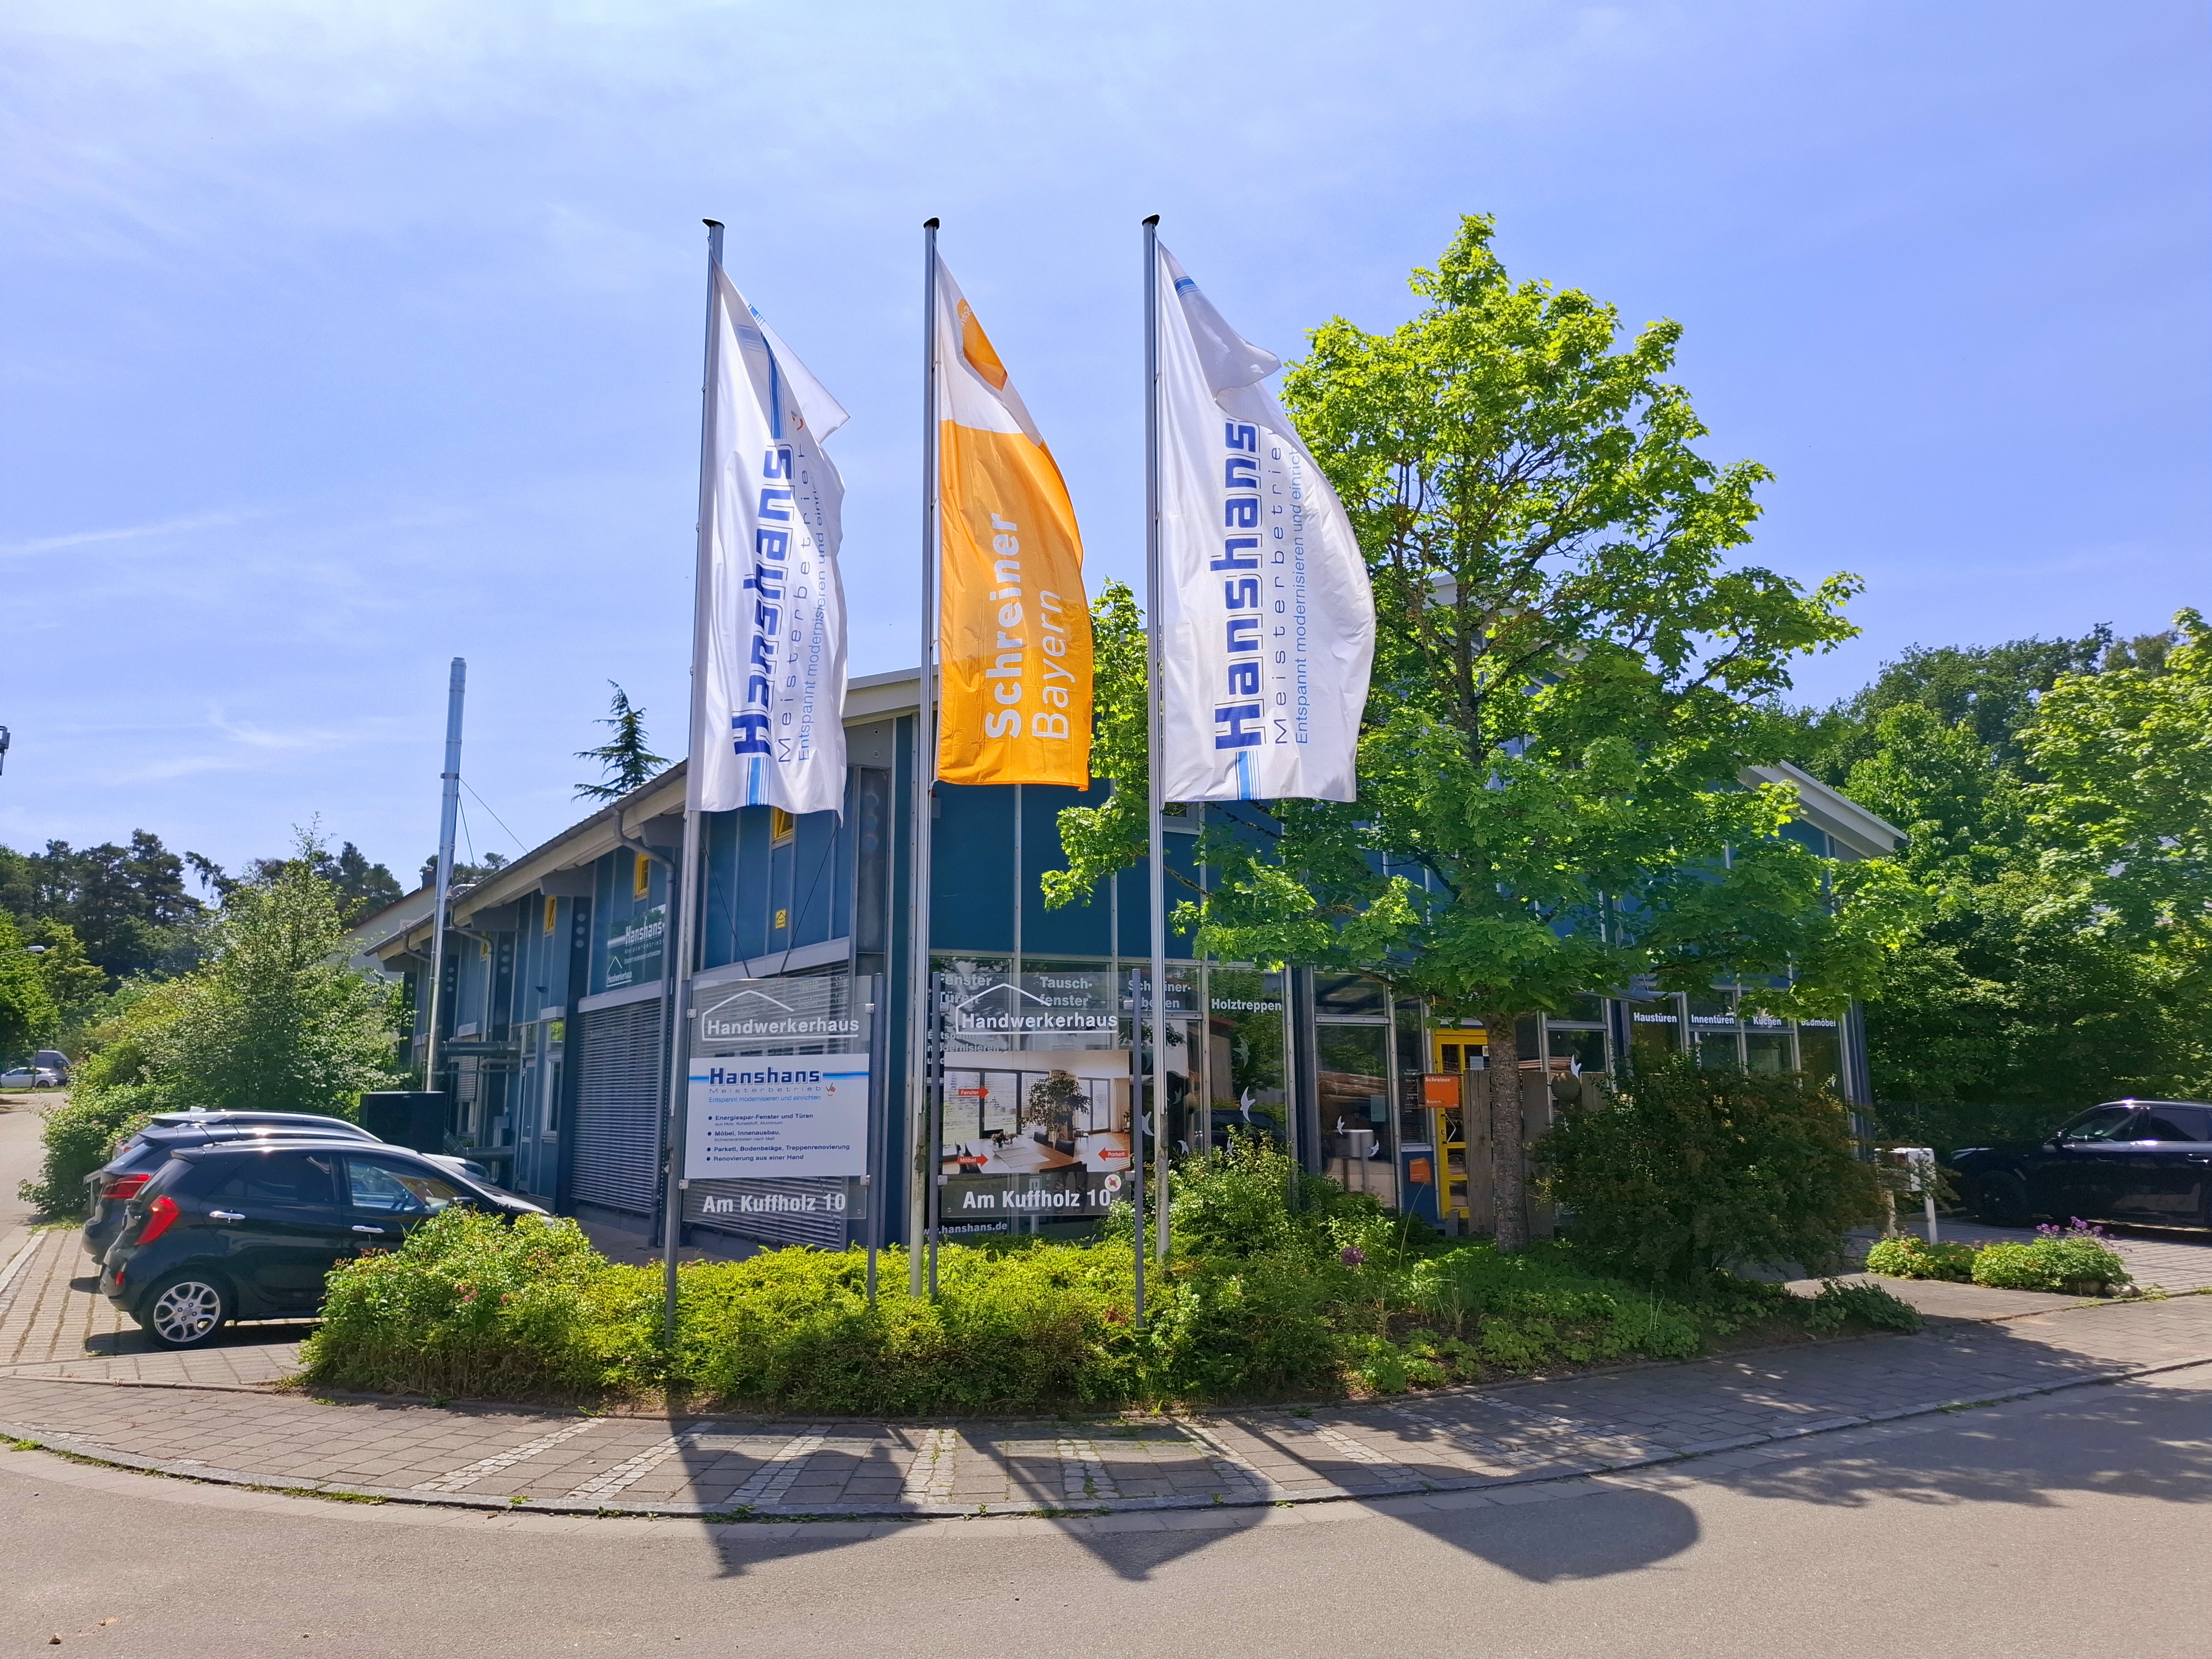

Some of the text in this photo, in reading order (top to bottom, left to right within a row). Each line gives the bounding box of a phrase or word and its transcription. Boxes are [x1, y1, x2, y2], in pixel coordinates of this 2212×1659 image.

[1290, 503, 1302, 532] und
[816, 532, 825, 564] und
[1210, 419, 1266, 750] Hanshans
[1268, 432, 1288, 745] Meisterbetrie
[1292, 537, 1307, 652] modernisieren
[732, 444, 795, 757] Hanshans
[807, 570, 826, 677] modernisieren
[985, 512, 1023, 739] Schreiner
[1032, 589, 1076, 739] Bayern
[1295, 657, 1310, 744] Entspannt
[798, 680, 816, 761] Entspannt
[626, 919, 662, 947] Hanshans
[1040, 976, 1092, 989] Tausch-
[1128, 980, 1192, 992] Shiner-
[1039, 994, 1089, 1007] fenster
[1211, 998, 1282, 1013] Holztreppen
[708, 1017, 859, 1035] Handwerkerhaus
[962, 1012, 1118, 1028] Handwerkerhaus
[1634, 1012, 1677, 1024] Haustüren
[1691, 1013, 1734, 1025] Innentüren
[1753, 1015, 1782, 1026] Küchen
[710, 1066, 822, 1085] Hanshans
[709, 1085, 821, 1094] Meisterbetrieb
[703, 1193, 846, 1213] Am Kuffholz 10
[963, 1188, 1111, 1208] Am Kuffholz 10
